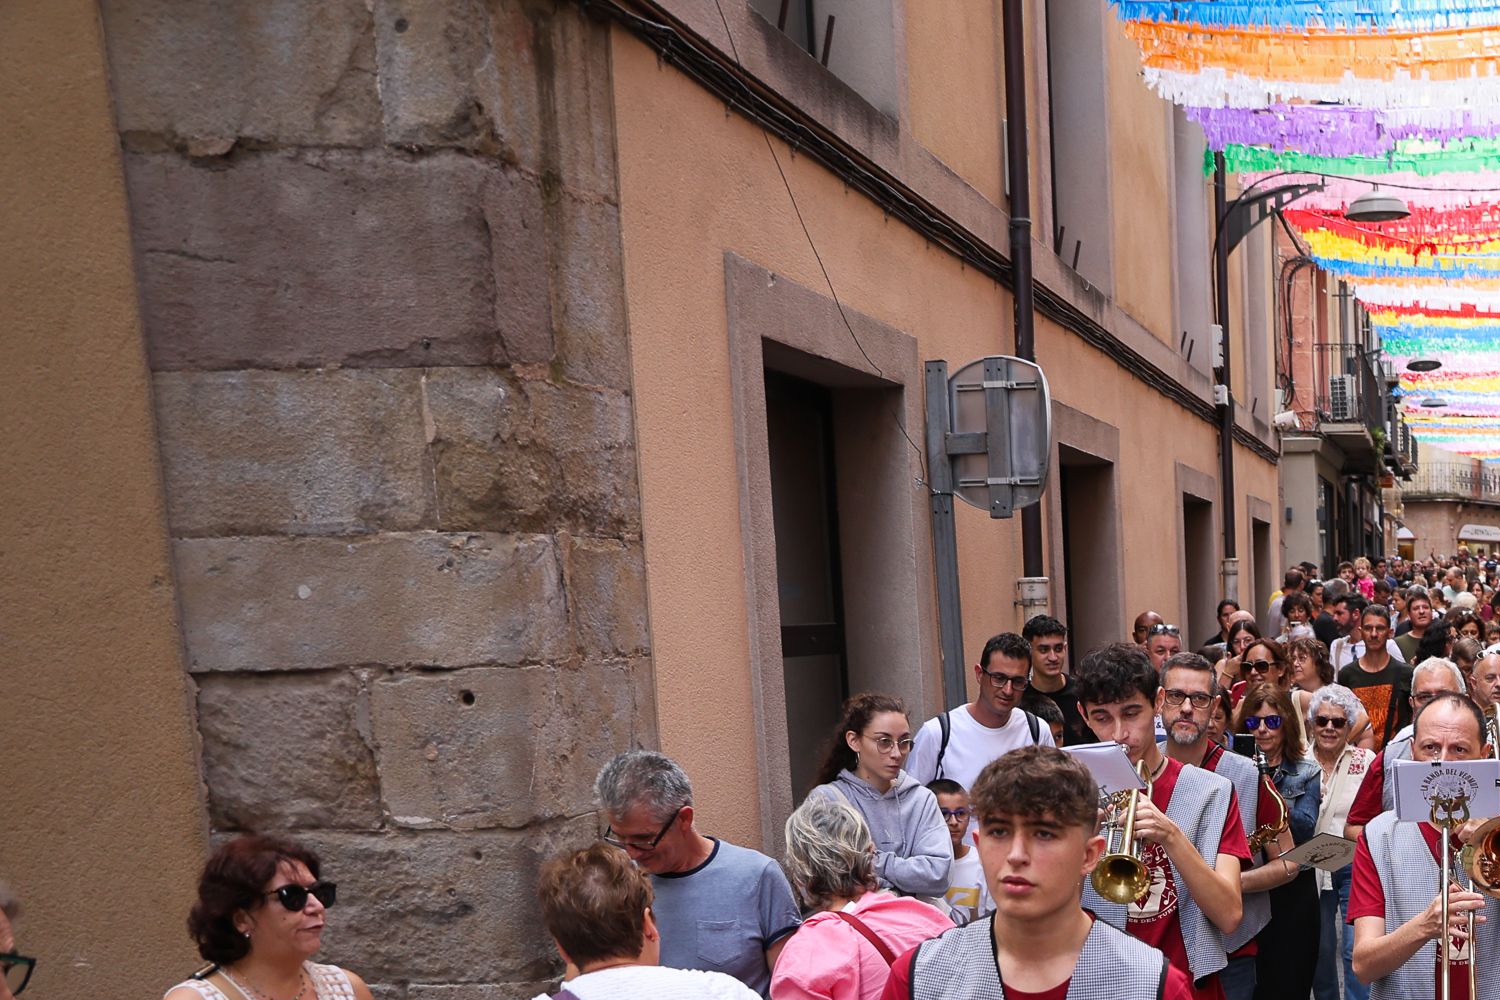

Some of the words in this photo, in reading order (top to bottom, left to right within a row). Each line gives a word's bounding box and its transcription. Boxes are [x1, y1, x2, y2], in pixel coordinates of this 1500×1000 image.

[1422, 770, 1444, 785] BANDA
[1445, 768, 1457, 776] DEL
[1458, 770, 1479, 790] VERMUT
[1420, 784, 1429, 792] LA
